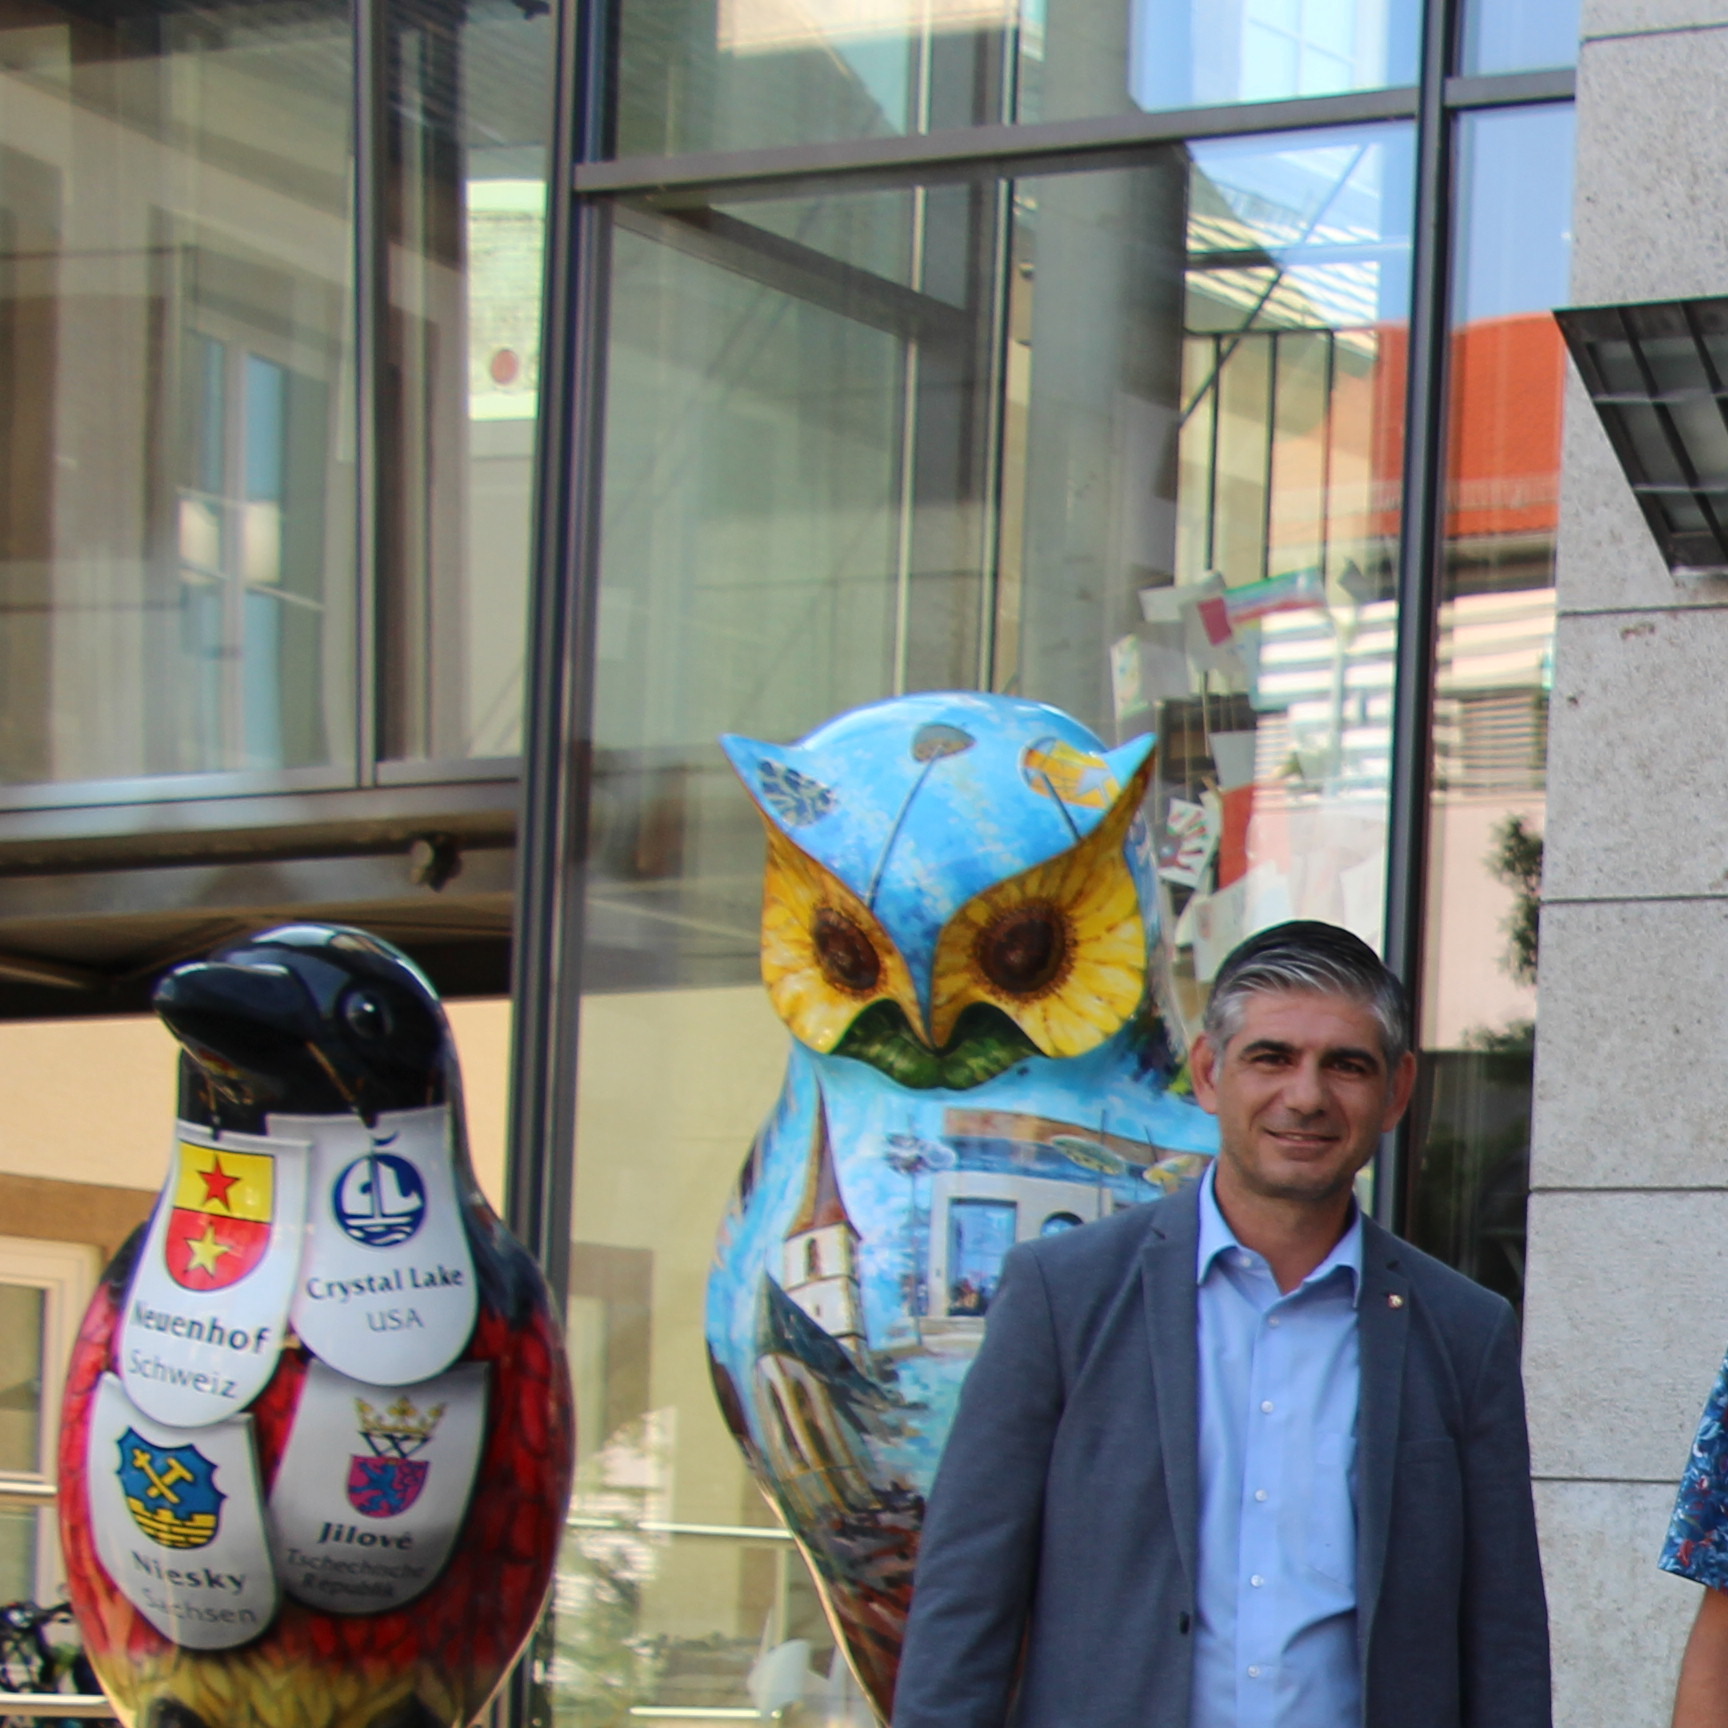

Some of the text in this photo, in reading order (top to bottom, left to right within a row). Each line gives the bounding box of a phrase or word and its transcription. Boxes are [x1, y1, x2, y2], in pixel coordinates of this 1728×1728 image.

[306, 1264, 464, 1302] Crystal Lake
[134, 1300, 270, 1353] Neuenhof
[366, 1308, 425, 1332] USA
[128, 1349, 237, 1399] Schweiz
[130, 1550, 246, 1596] Niesky
